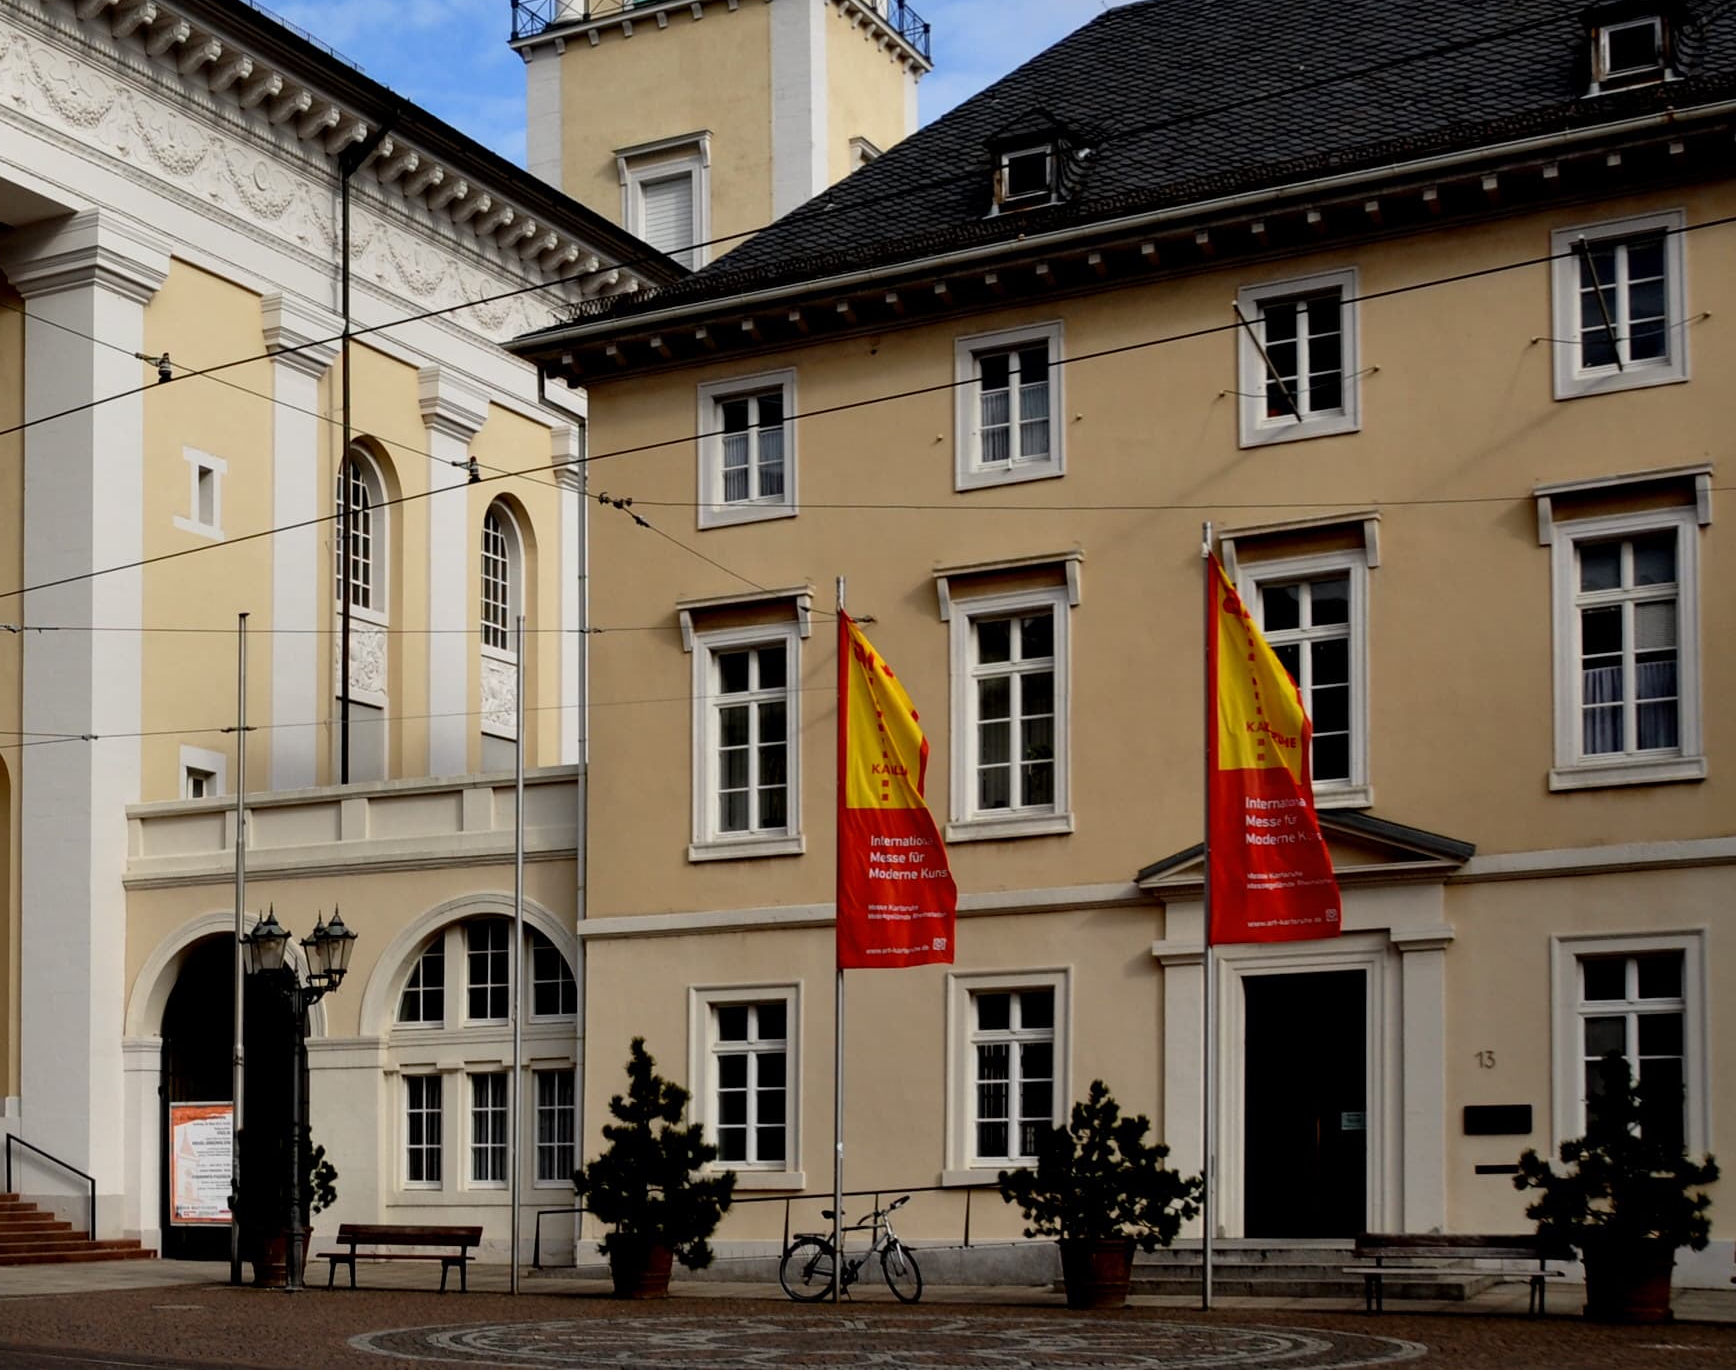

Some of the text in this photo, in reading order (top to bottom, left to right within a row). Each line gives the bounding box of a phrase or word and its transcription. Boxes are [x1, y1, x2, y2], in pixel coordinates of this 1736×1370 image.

[1245, 814, 1282, 828] Messe
[1245, 832, 1296, 845] Moderne
[870, 851, 925, 863] Messe für
[869, 868, 918, 880] Moderne
[1474, 1050, 1496, 1069] 13
